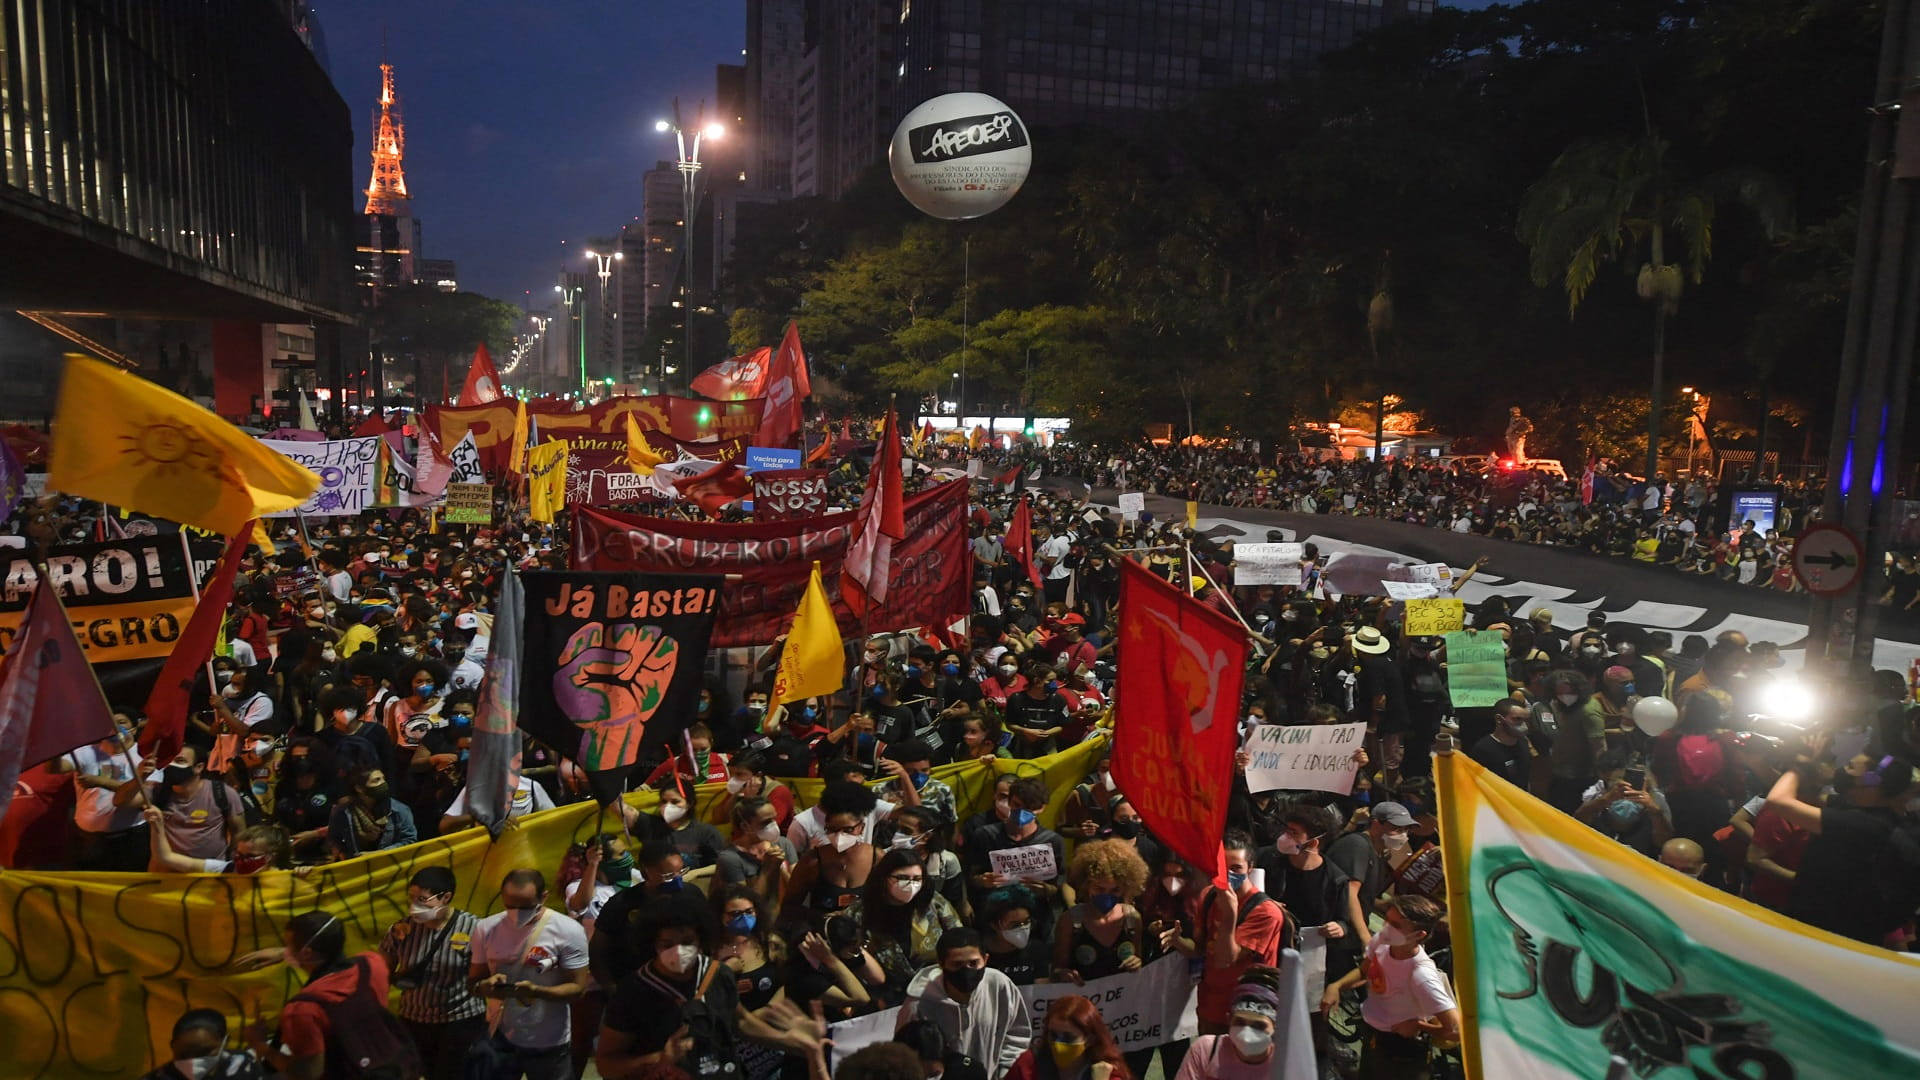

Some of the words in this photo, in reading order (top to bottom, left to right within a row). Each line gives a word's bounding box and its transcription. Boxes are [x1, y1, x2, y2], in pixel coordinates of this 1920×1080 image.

[610, 475, 641, 487] FORA
[755, 478, 828, 498] NOSSA
[608, 488, 639, 501] BASTA
[768, 495, 822, 513] VOZ
[545, 583, 595, 619] Já
[606, 585, 717, 619] Basta!
[1261, 727, 1313, 745] VACINA
[1105, 987, 1125, 1003] DE
[1124, 1023, 1162, 1043] LEME
